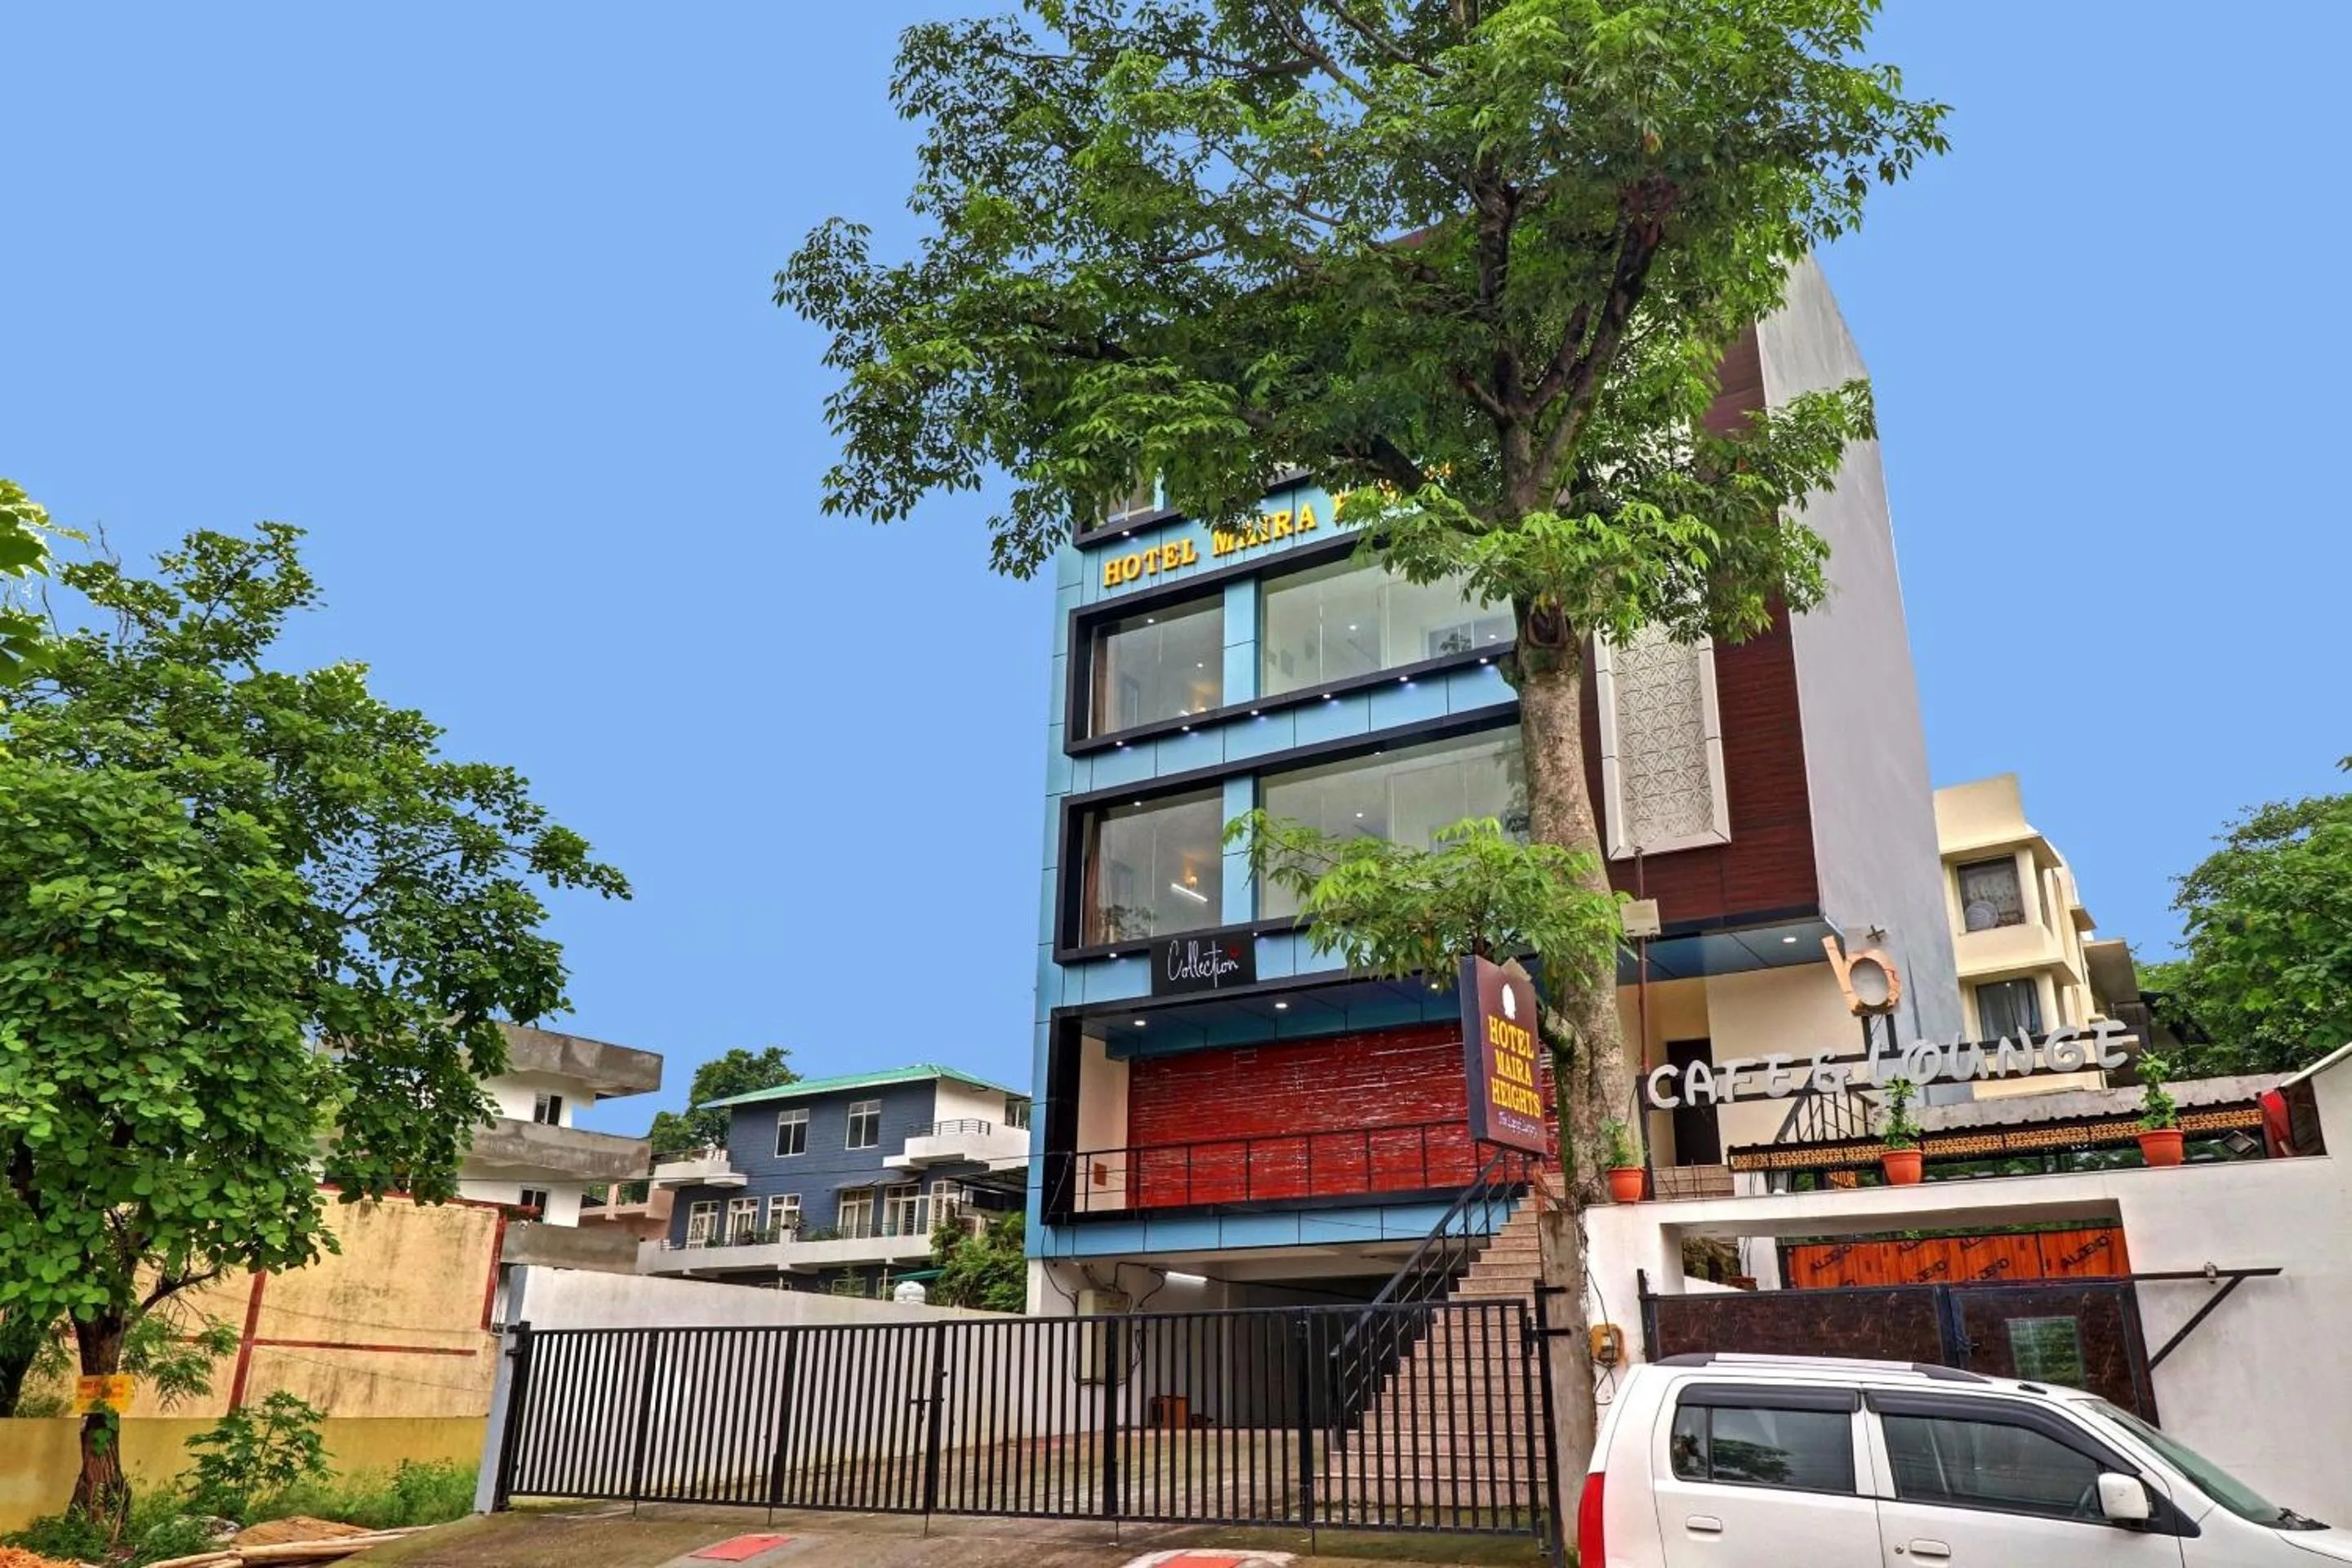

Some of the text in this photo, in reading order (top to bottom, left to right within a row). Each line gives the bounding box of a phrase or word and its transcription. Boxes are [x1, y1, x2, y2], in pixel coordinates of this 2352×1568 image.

[1103, 537, 1199, 587] HOTEL
[1168, 940, 1239, 989] Collection
[1488, 1015, 1535, 1059] HOTEL
[1494, 1049, 1534, 1087] MAIRA
[1648, 1020, 2129, 1110] CAFE & LOUNGE
[1490, 1076, 1541, 1118] HEIGHTS
